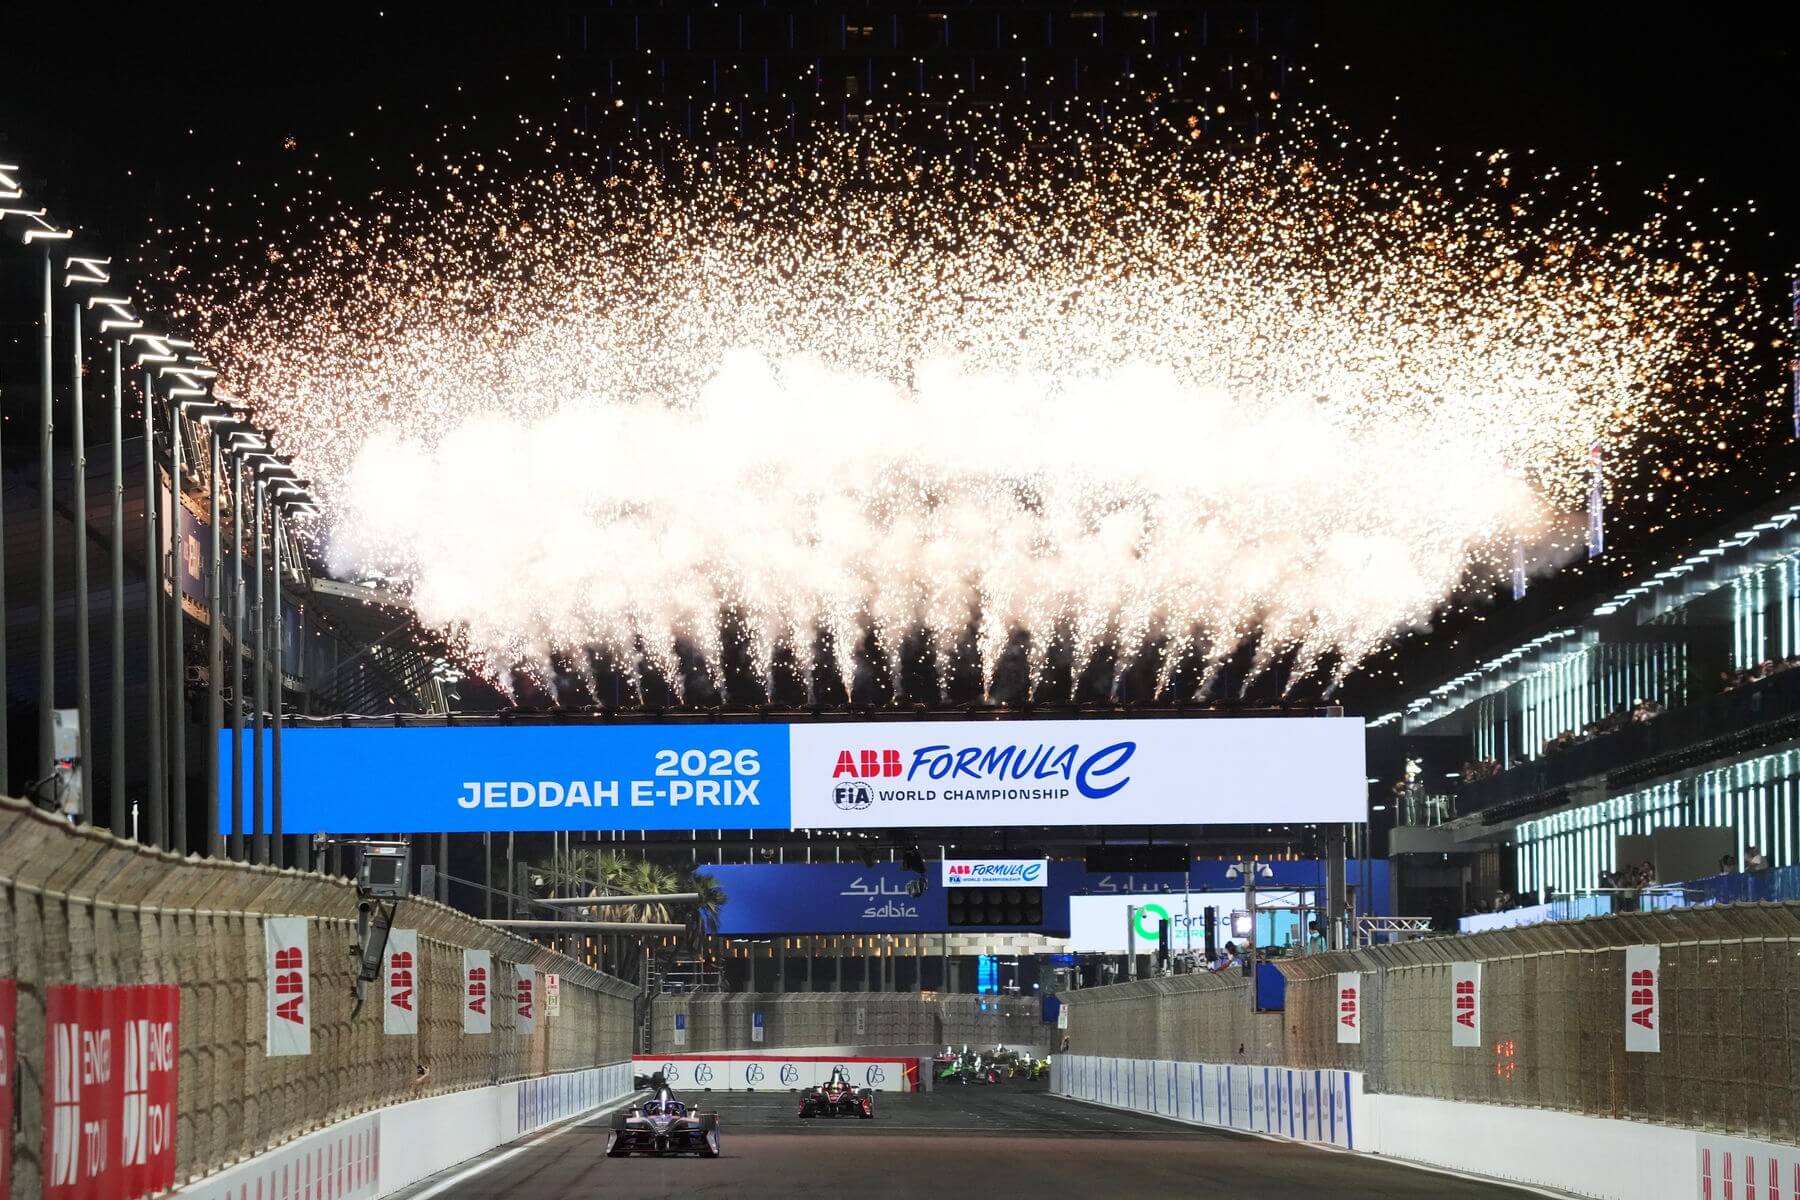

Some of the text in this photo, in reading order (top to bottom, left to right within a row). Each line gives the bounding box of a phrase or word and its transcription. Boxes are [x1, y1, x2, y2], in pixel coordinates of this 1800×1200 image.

[655, 749, 761, 776] 2026
[832, 749, 904, 778] ABB
[907, 744, 1079, 782] FORMULA
[457, 777, 761, 809] JEDDAH E-PRIX
[879, 790, 937, 801] WORLD
[943, 788, 1070, 801] CHAMPIONSHIP
[949, 865, 971, 875] ABB
[971, 864, 1024, 876] FORMULA
[275, 946, 304, 1024] ABB
[391, 951, 413, 1011] ABB
[469, 967, 486, 1015] ABB
[517, 979, 532, 1019] ABB
[1631, 969, 1654, 1030] ABB
[1341, 987, 1357, 1028] ABB
[1456, 980, 1475, 1029] ABB
